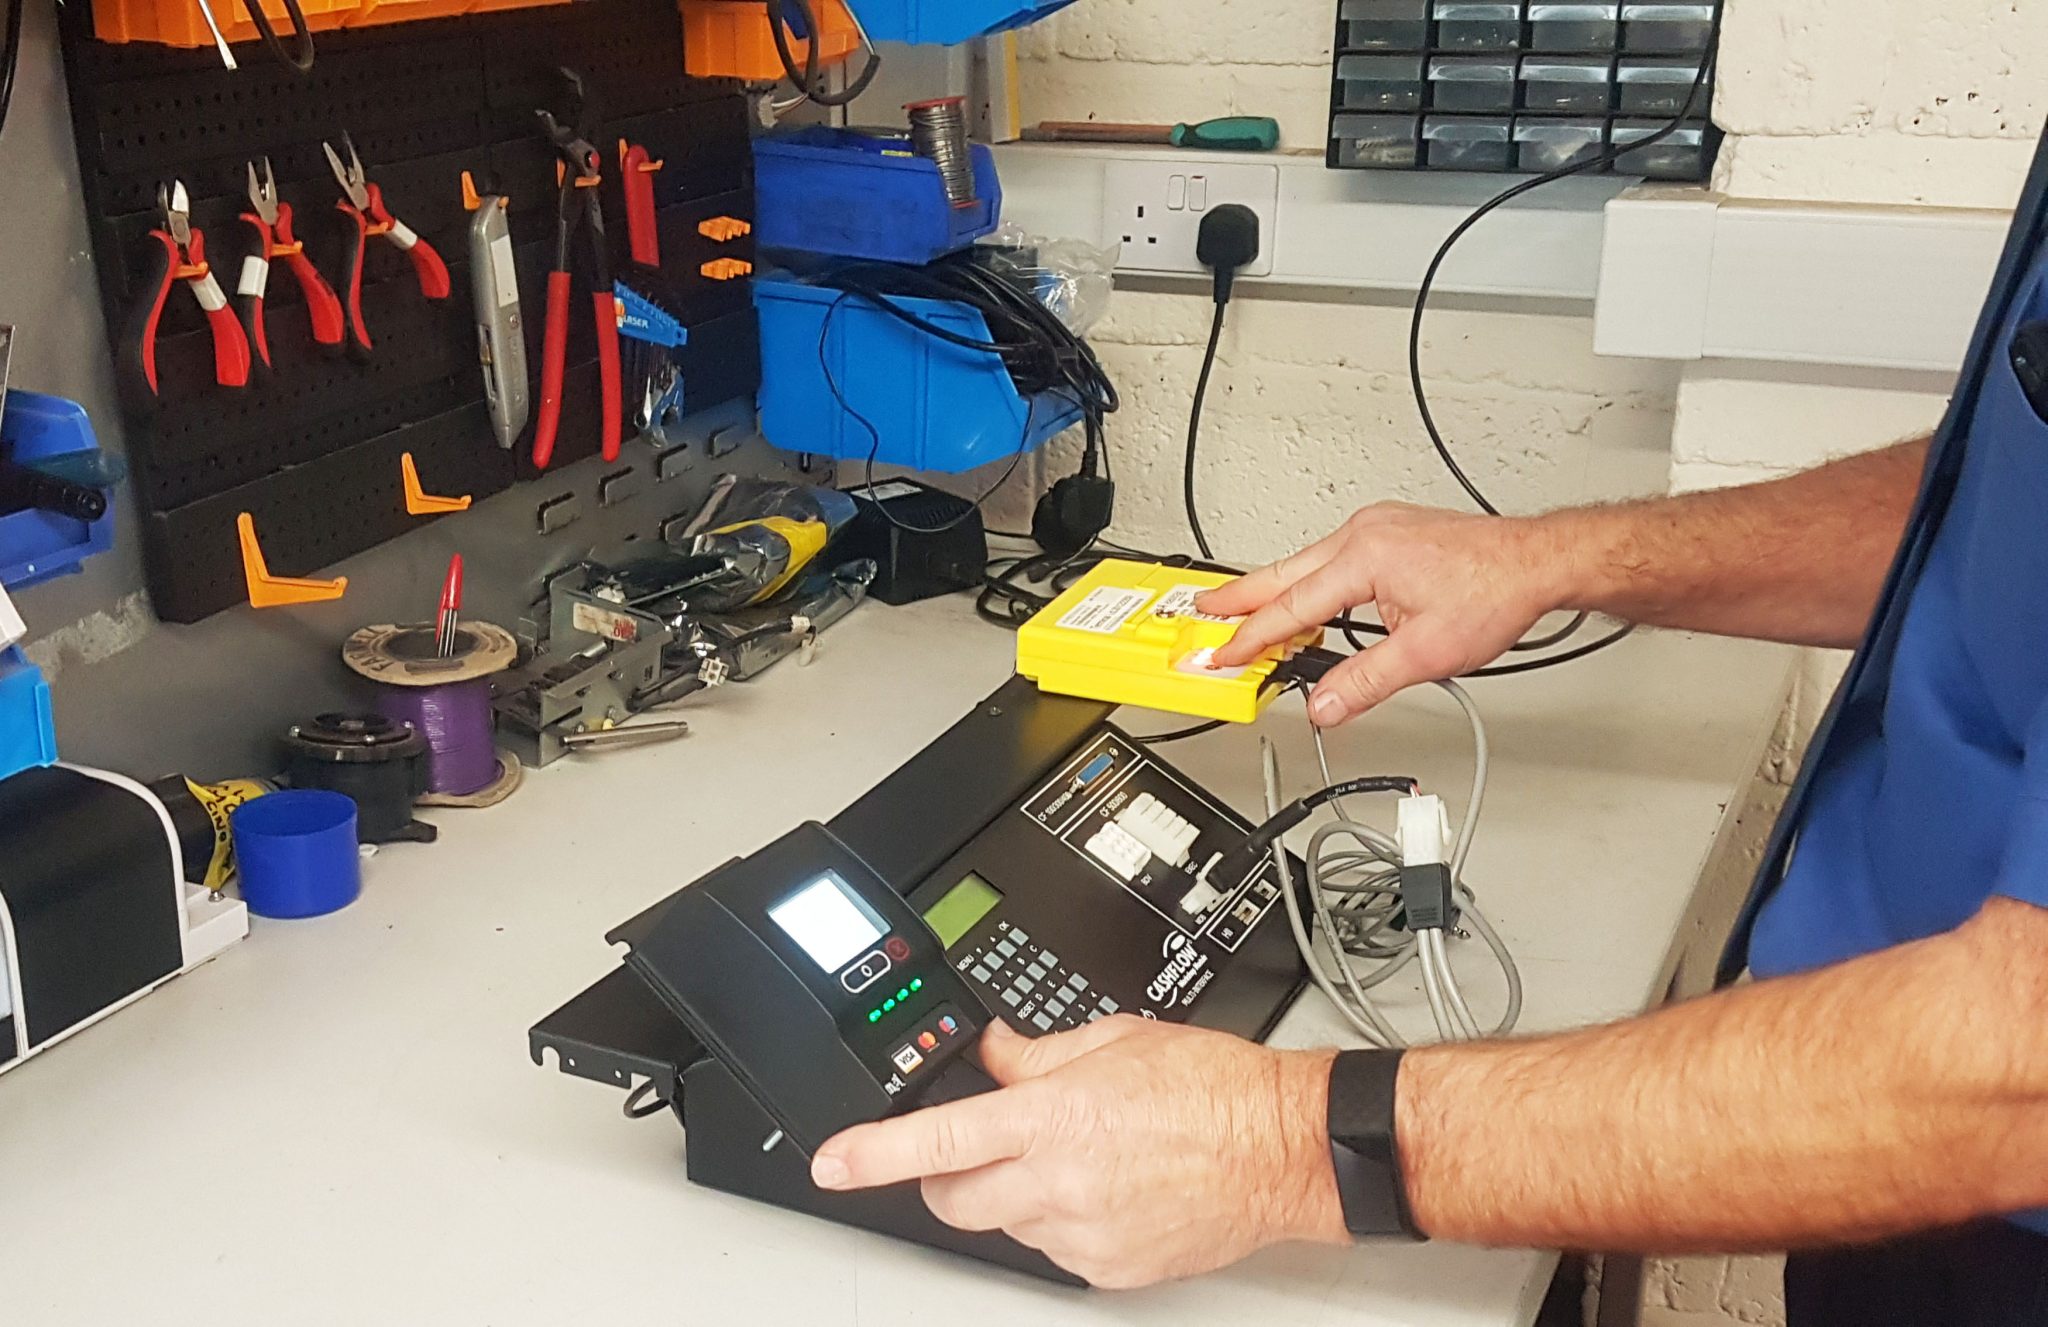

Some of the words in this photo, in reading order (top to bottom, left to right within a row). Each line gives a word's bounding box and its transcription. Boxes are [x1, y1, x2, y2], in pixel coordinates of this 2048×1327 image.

[956, 953, 975, 972] MENU
[1146, 941, 1198, 1002] CASHFLOW
[1016, 999, 1036, 1020] RESET
[899, 1051, 916, 1066] VISA
